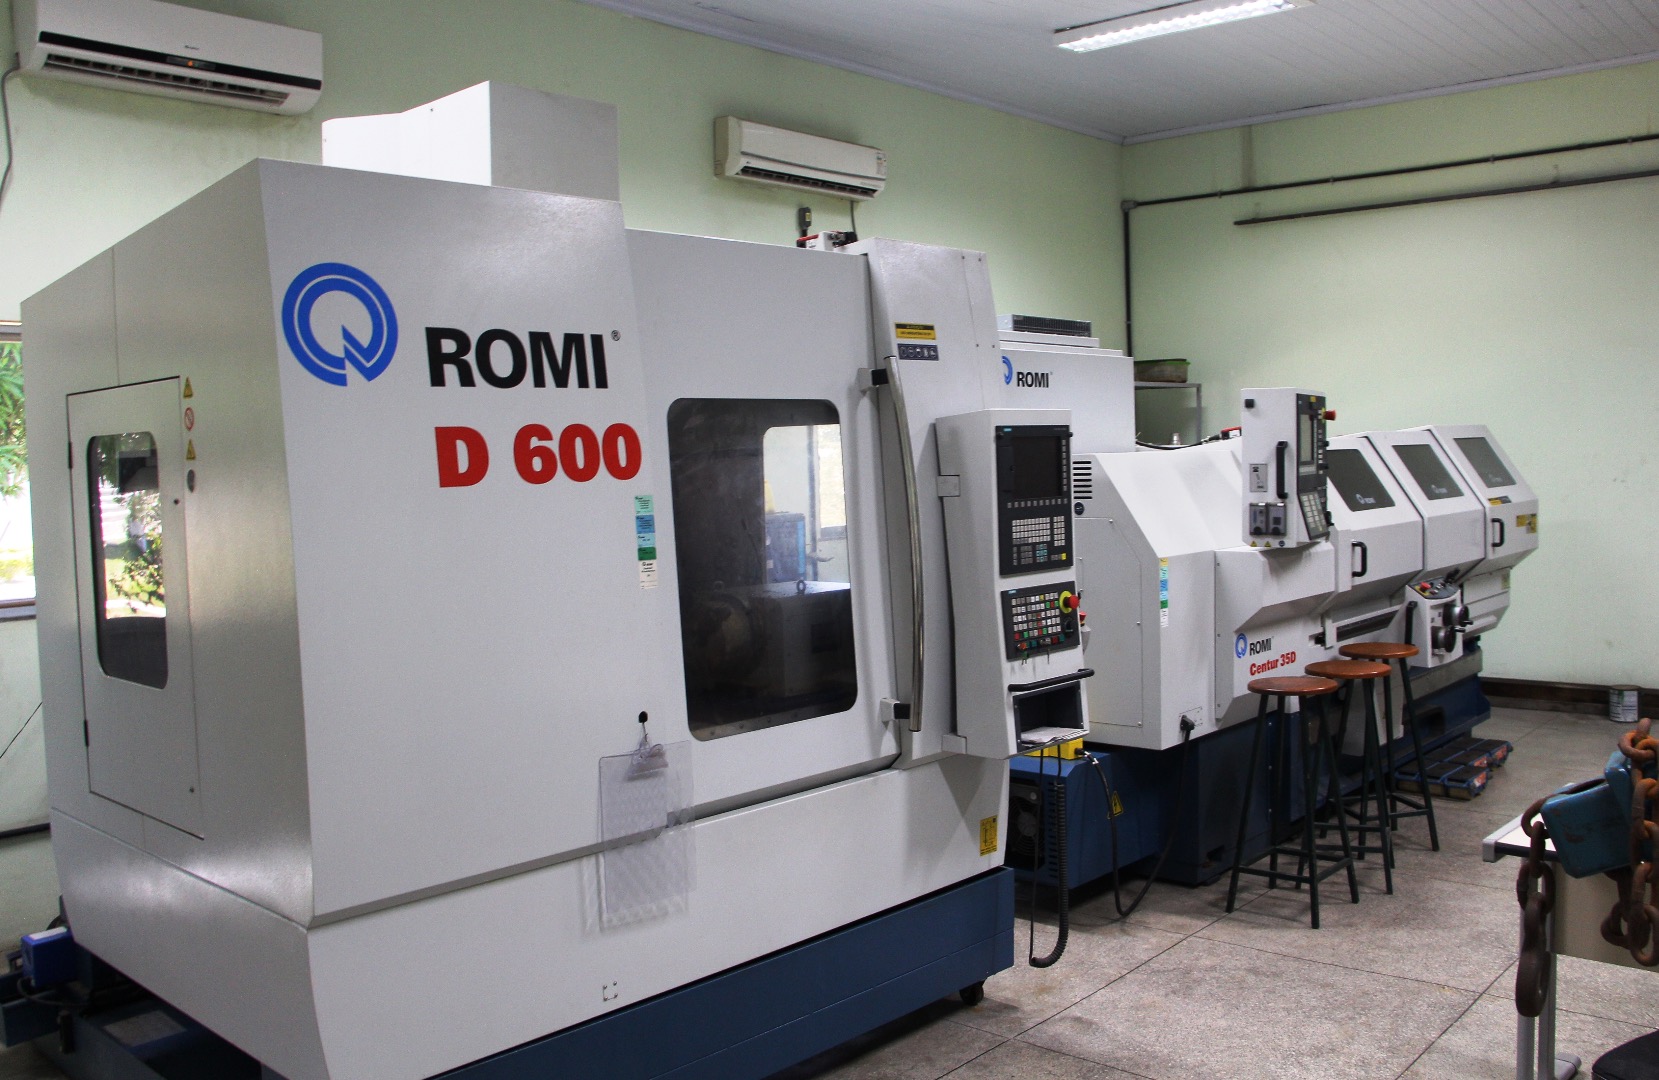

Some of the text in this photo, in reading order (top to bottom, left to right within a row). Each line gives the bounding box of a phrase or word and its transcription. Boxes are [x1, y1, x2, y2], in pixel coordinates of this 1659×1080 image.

[425, 327, 608, 389] ROMI
[1016, 371, 1049, 388] ROMI
[434, 423, 642, 488] D 600
[1249, 638, 1272, 656] ROMI
[1249, 651, 1297, 676] Centur 35D
